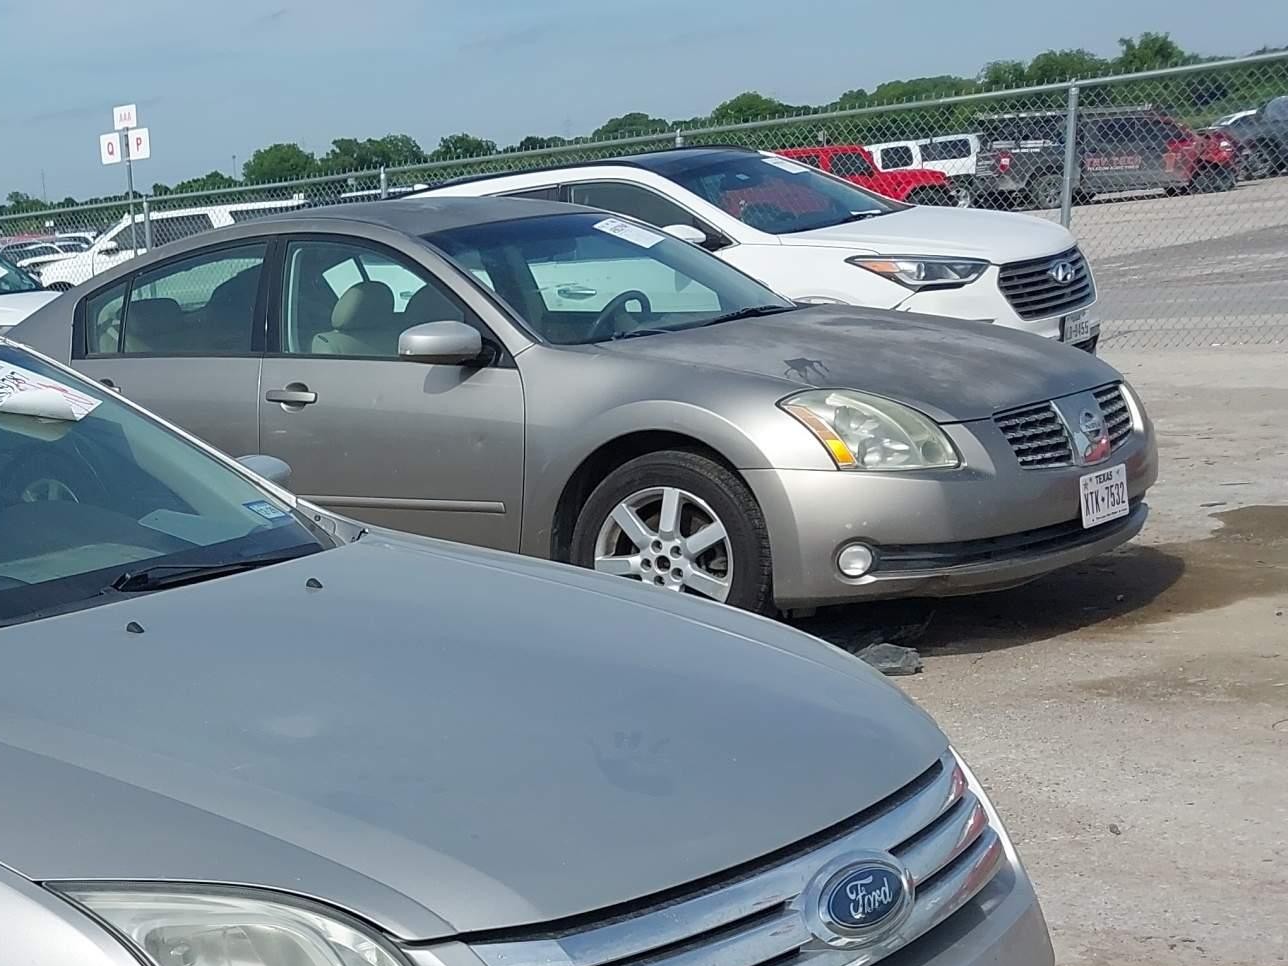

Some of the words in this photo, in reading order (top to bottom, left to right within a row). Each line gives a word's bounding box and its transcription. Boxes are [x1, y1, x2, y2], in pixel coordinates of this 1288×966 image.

[107, 142, 115, 155] Q
[136, 137, 142, 152] P
[1095, 471, 1113, 484] TEXAS
[846, 875, 893, 919] Ford
